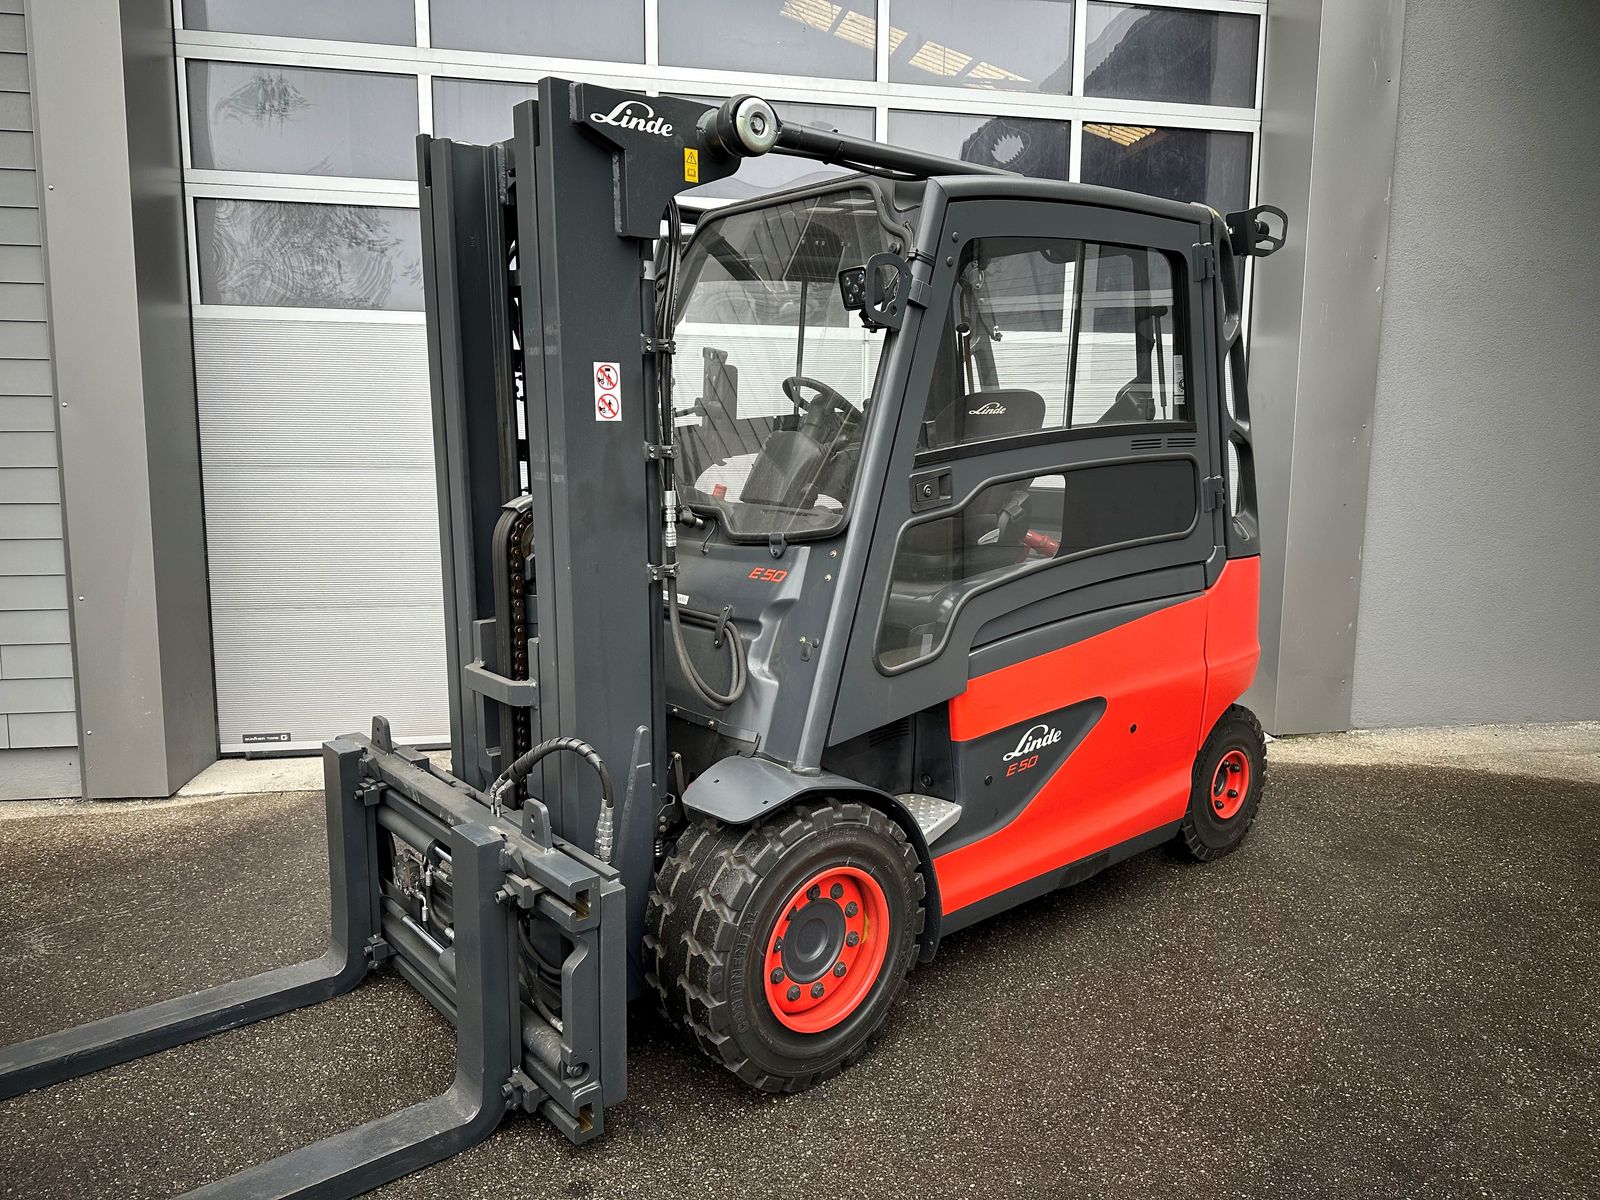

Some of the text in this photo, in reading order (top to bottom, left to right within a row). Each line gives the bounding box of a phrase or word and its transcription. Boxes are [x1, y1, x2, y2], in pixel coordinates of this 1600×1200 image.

[590, 100, 673, 137] Linde
[968, 401, 1007, 415] Linde
[1002, 724, 1062, 762] Linde
[730, 910, 760, 1033] CONTINENTAL
